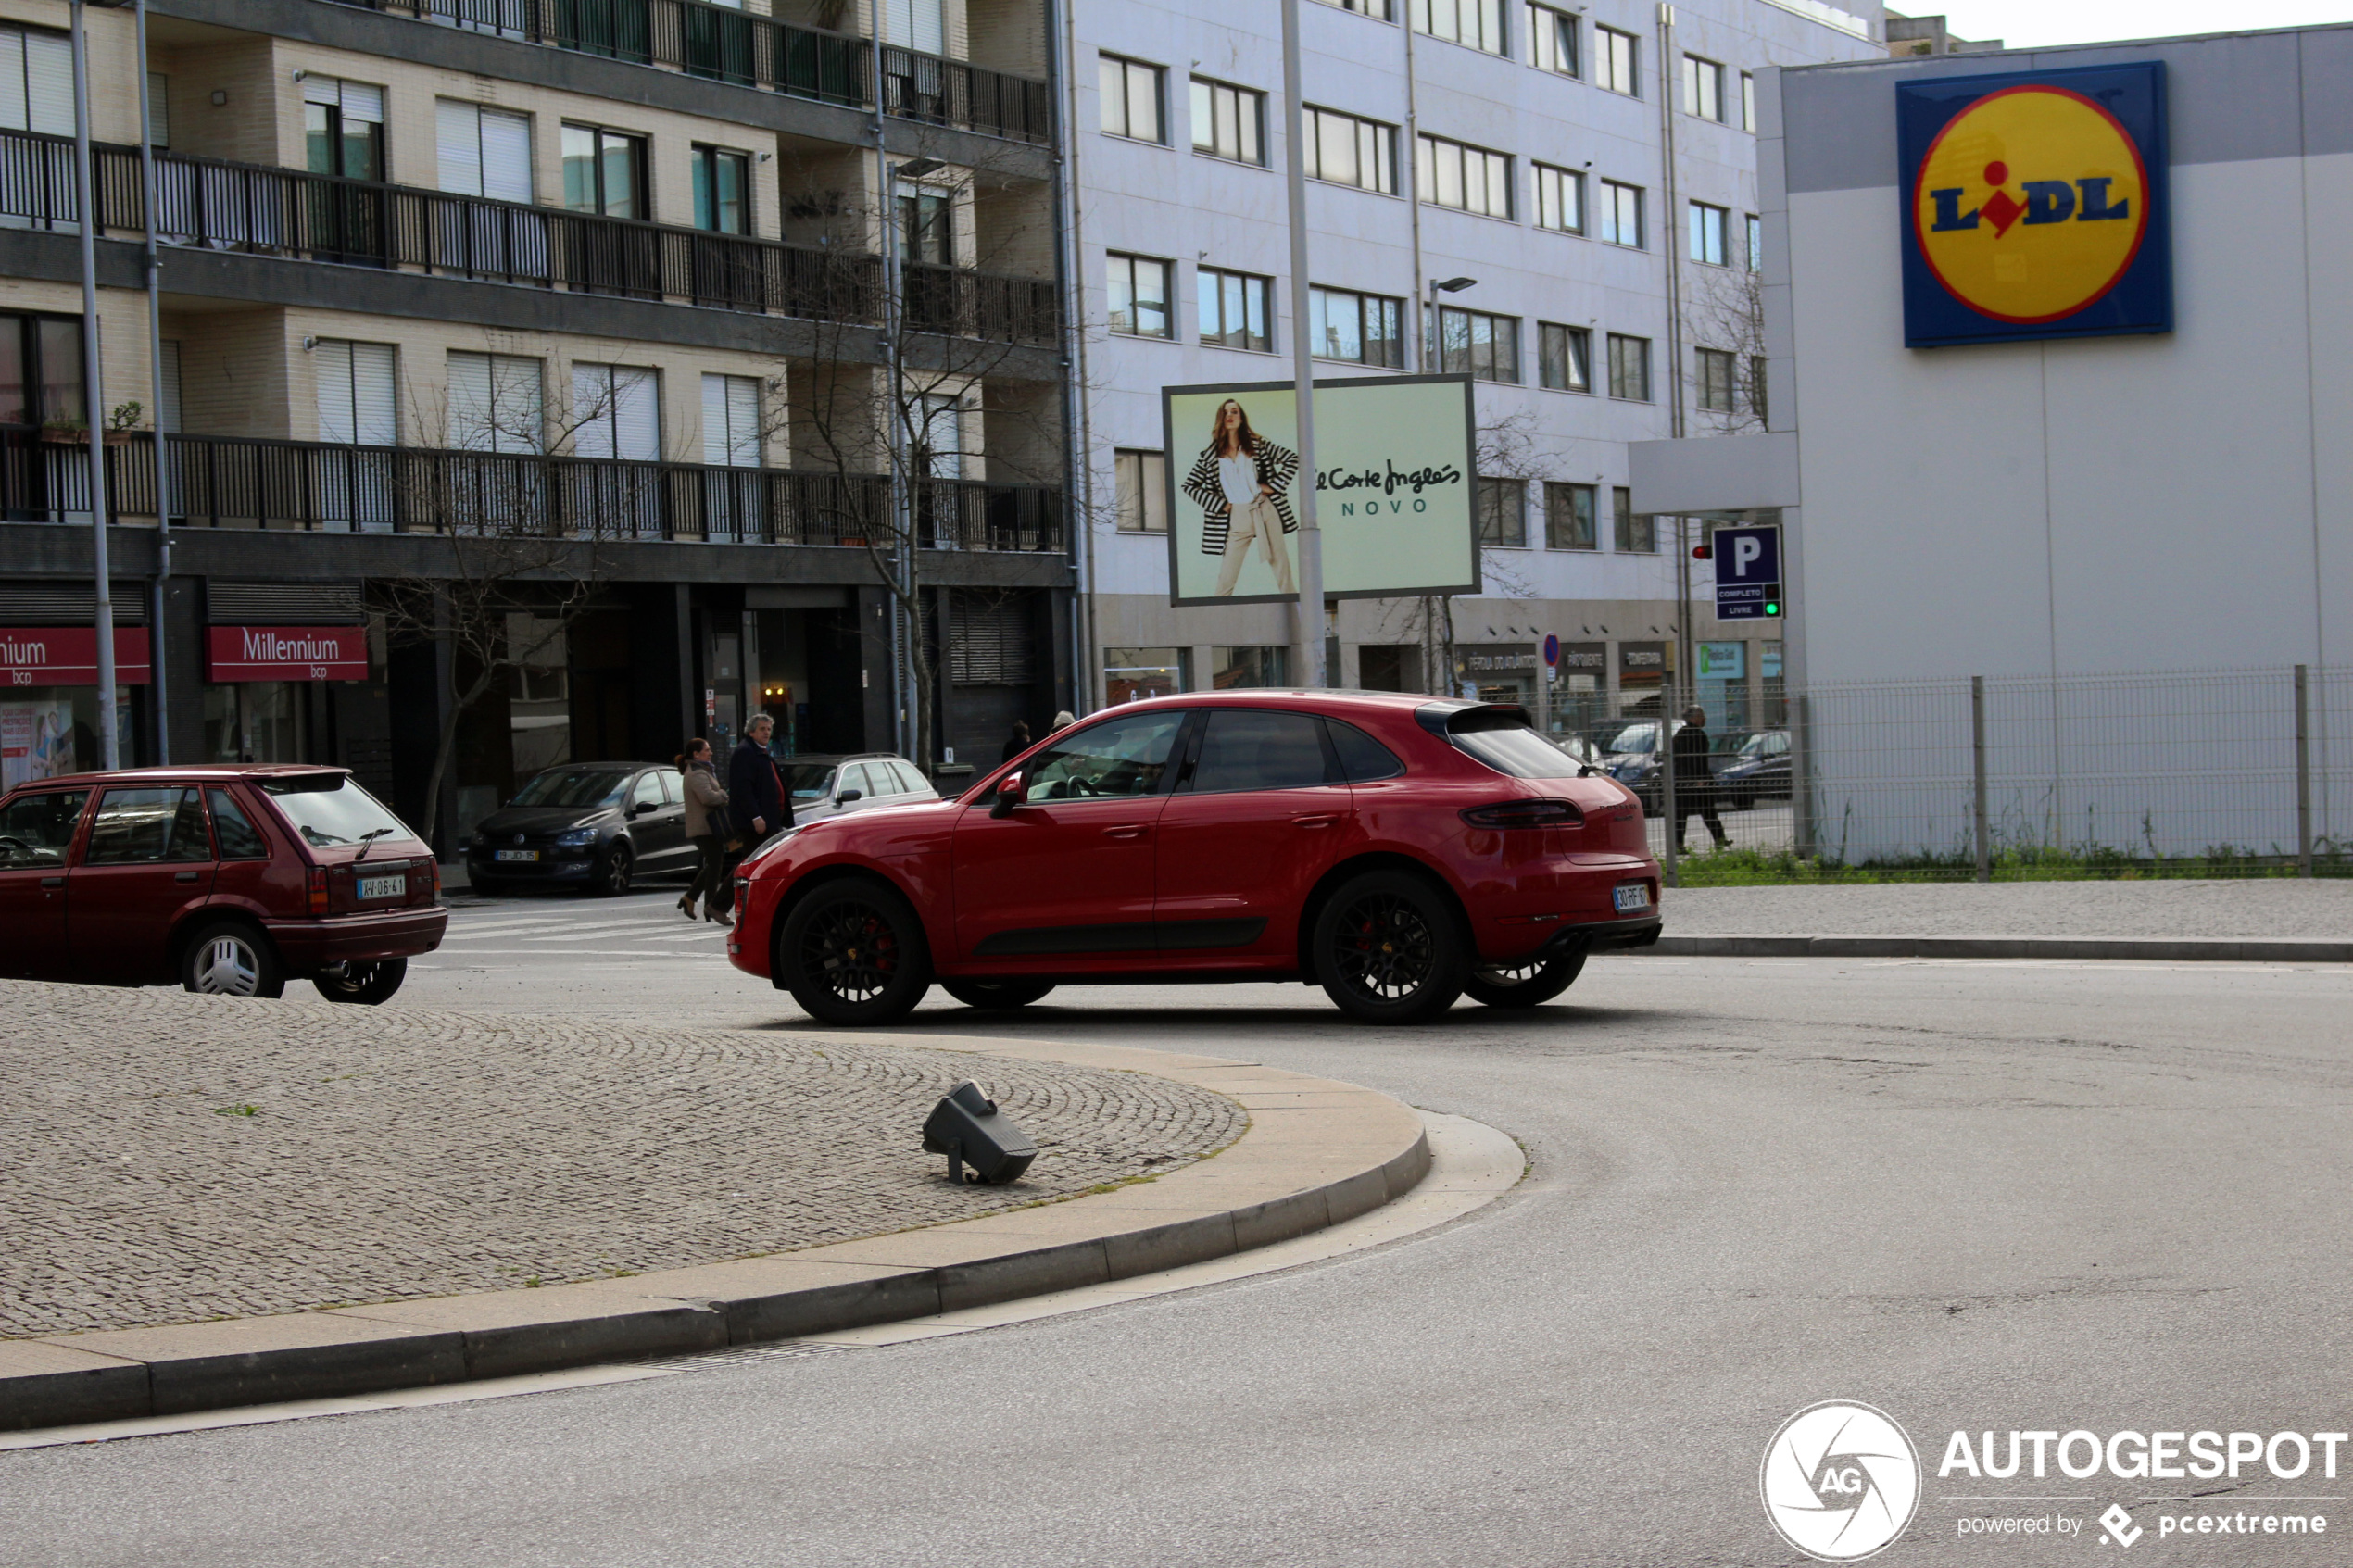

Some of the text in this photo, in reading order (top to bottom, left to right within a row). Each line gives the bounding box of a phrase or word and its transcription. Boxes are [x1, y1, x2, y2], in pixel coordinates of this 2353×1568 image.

[1328, 468, 1381, 490] Corte
[1385, 459, 1461, 495] Inglés
[1341, 499, 1427, 516] NOVO
[1734, 536, 1761, 576] P
[1718, 589, 1761, 597] COMPLETO
[242, 627, 339, 660] Millennium
[12, 668, 31, 686] bcp
[310, 664, 327, 680] bcp
